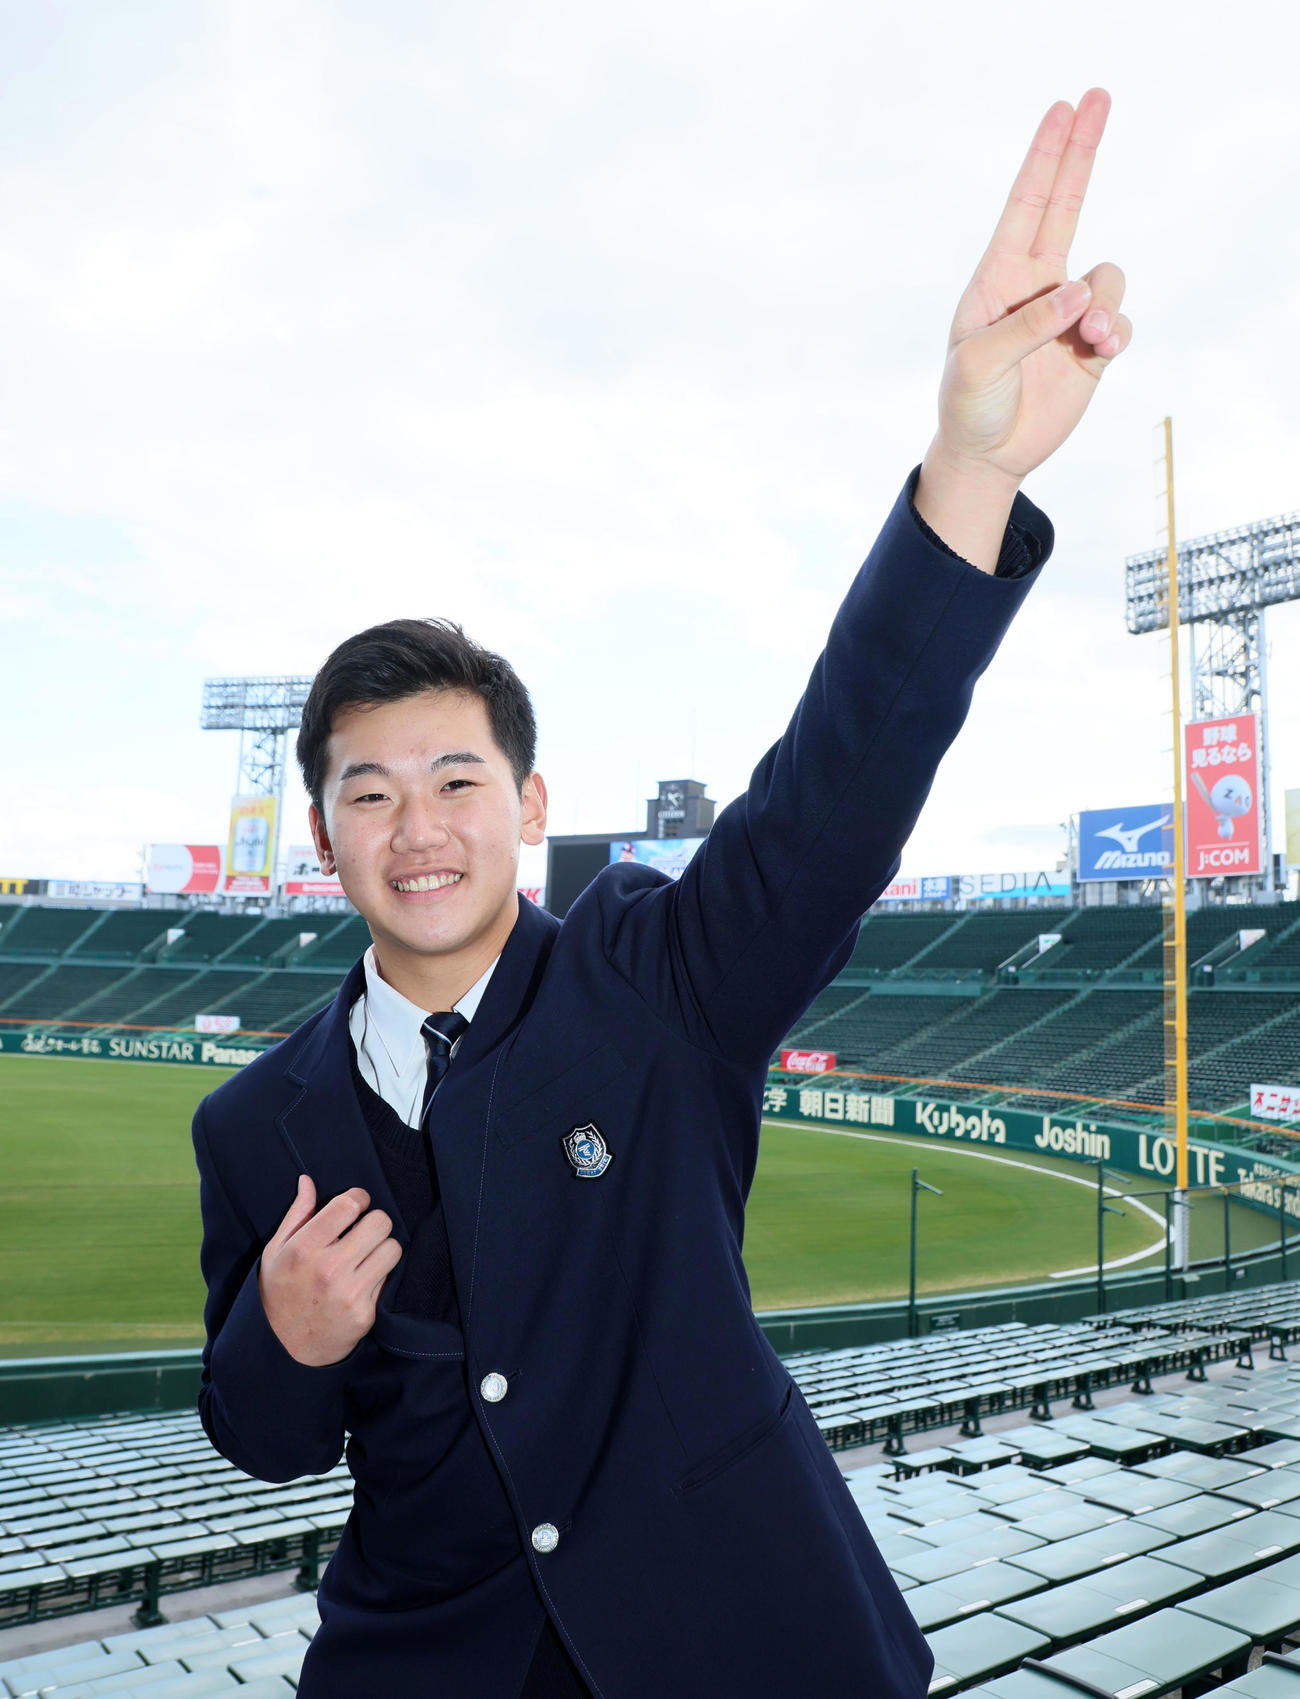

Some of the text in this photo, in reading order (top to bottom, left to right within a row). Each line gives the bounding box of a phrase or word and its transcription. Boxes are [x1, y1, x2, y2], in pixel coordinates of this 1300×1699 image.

[1203, 724, 1237, 746] 野球
[1191, 742, 1252, 768] 見るなら
[1198, 847, 1249, 870] J:COM
[884, 878, 917, 896] ani
[108, 1038, 194, 1062] SUNSTAR
[201, 1042, 264, 1065] Panas
[799, 1089, 895, 1126] 朝日新聞
[915, 1101, 1006, 1144] Kubota
[1034, 1116, 1111, 1160] Joshin
[1139, 1134, 1226, 1189] LOTE
